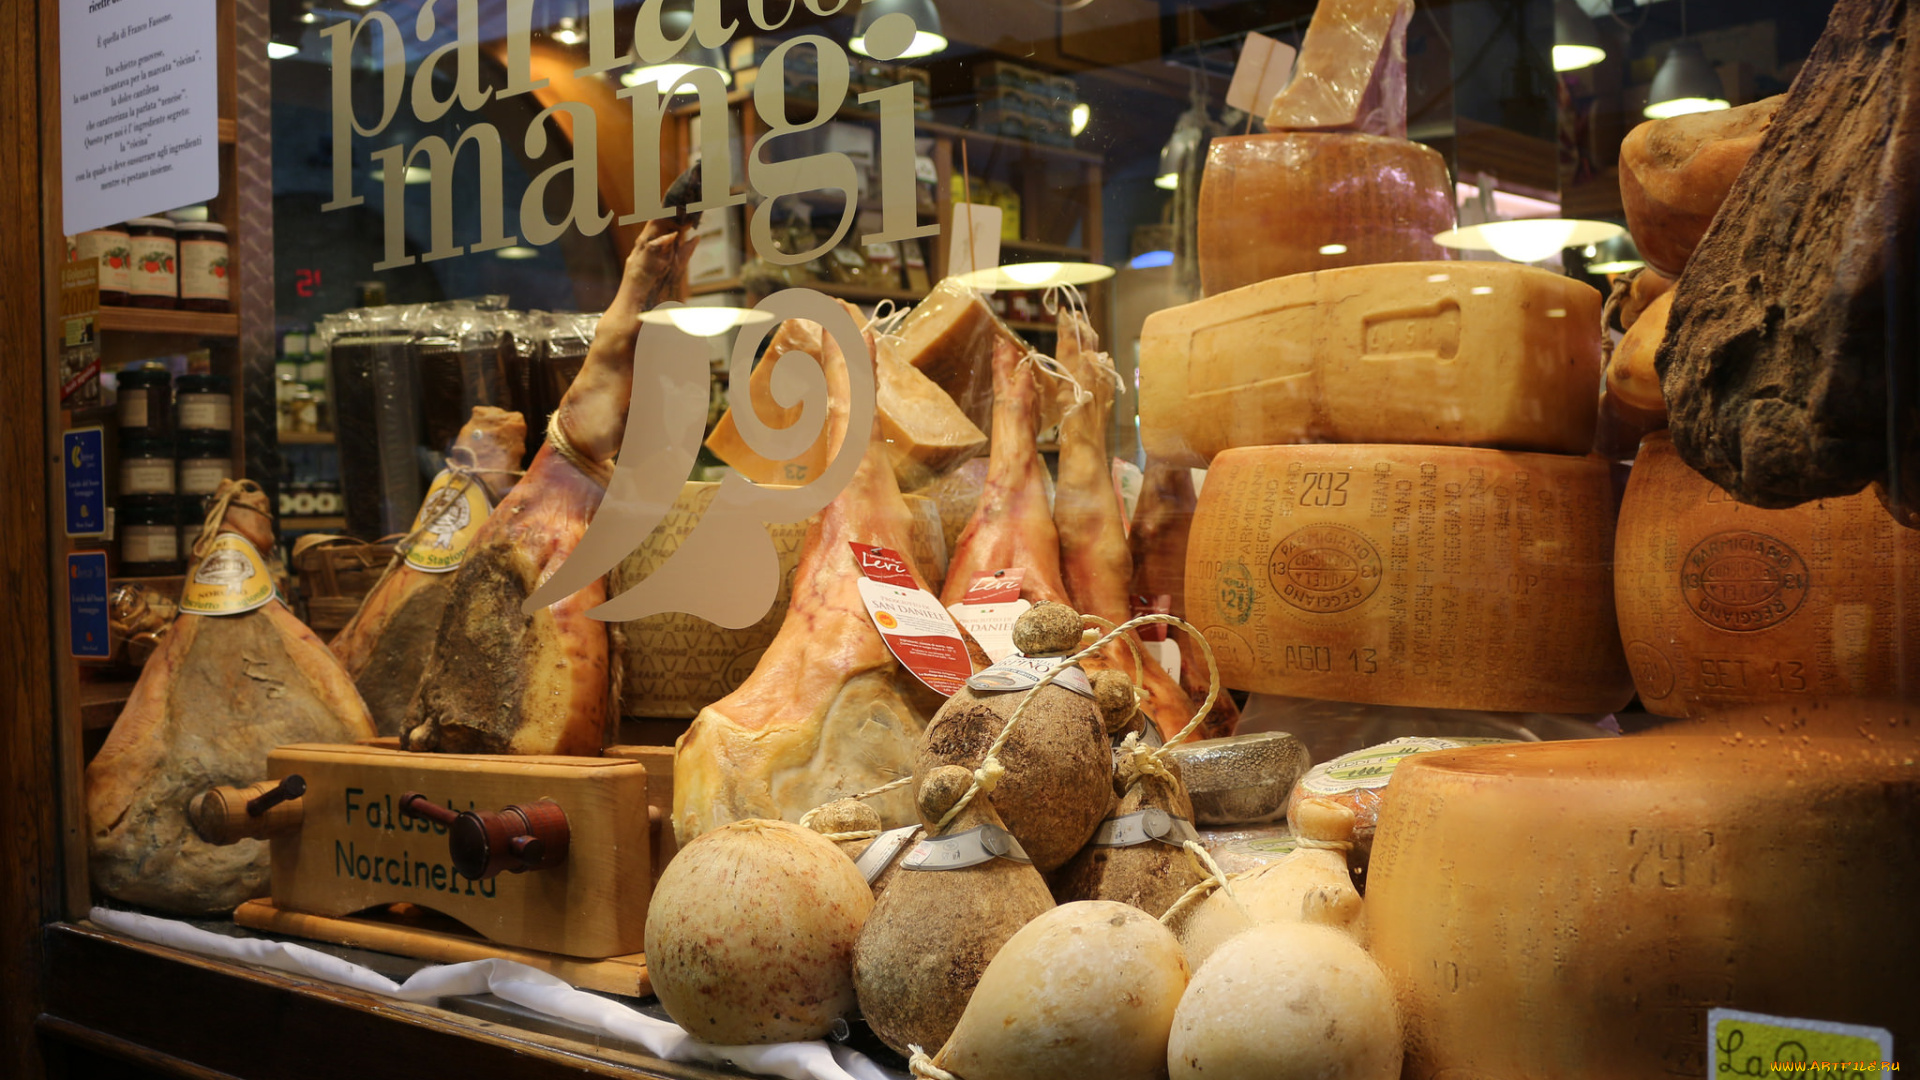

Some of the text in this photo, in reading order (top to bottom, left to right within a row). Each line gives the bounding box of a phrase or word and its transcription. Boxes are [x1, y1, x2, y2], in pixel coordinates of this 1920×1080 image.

[120, 28, 126, 39] di
[127, 25, 147, 36] Franco
[130, 75, 140, 87] per
[141, 70, 146, 80] la
[111, 96, 116, 106] la
[129, 107, 135, 116] la
[136, 101, 156, 118] parlata
[104, 133, 113, 145] per
[371, 13, 940, 271] mangi
[86, 169, 91, 179] la
[1299, 472, 1351, 507] 293
[1416, 462, 1438, 573] PARMIGIANO
[1272, 562, 1286, 576] 13
[1284, 584, 1363, 608] REGGIANO
[872, 600, 945, 621] SAN DANIELE
[1699, 599, 1787, 624] REGGIANO
[970, 622, 1014, 632] DANIE
[1285, 645, 1378, 674] AGO 13
[1700, 659, 1807, 691] SET 13
[1716, 1029, 1769, 1079] La
